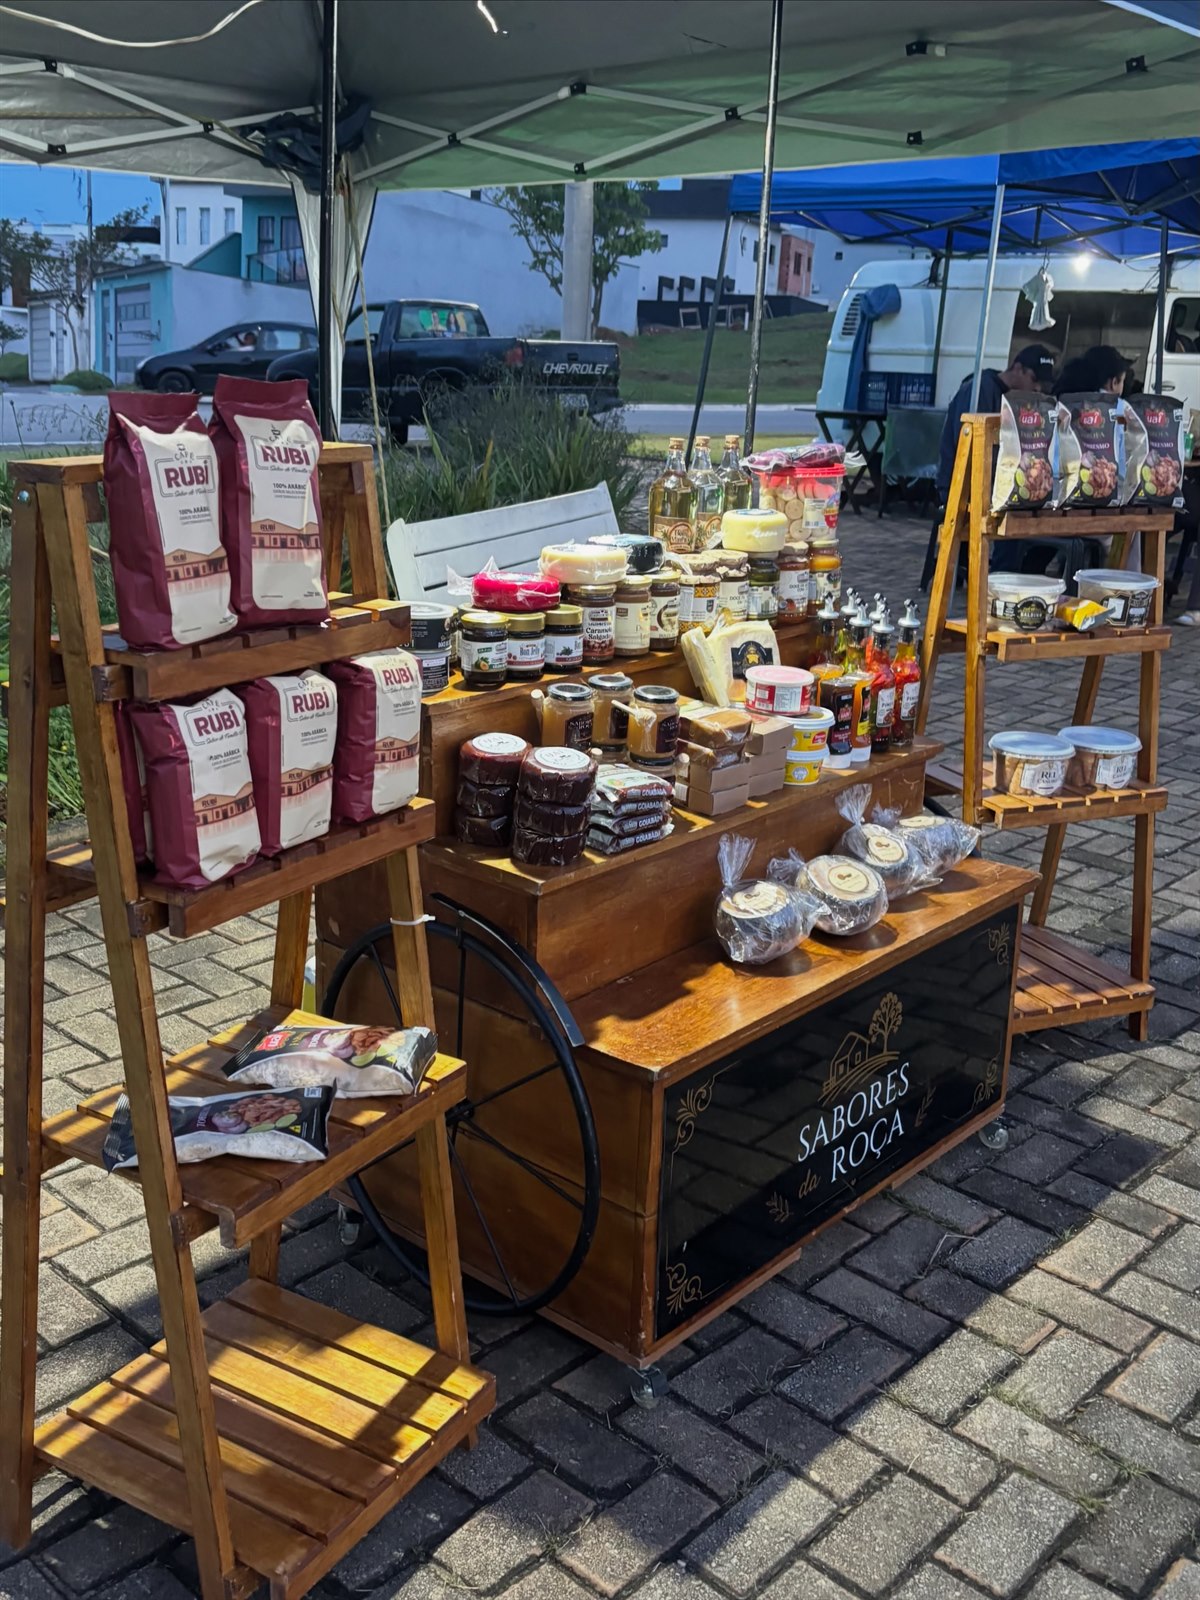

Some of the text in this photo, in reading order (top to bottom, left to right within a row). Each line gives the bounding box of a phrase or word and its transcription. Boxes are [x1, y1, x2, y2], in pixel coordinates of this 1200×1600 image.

[542, 362, 609, 375] CHEVROLET
[287, 482, 307, 490] ARÁBIC
[639, 814, 663, 827] GOIABAD
[797, 1061, 910, 1162] SABORES
[798, 1109, 905, 1199] da ROÇA
